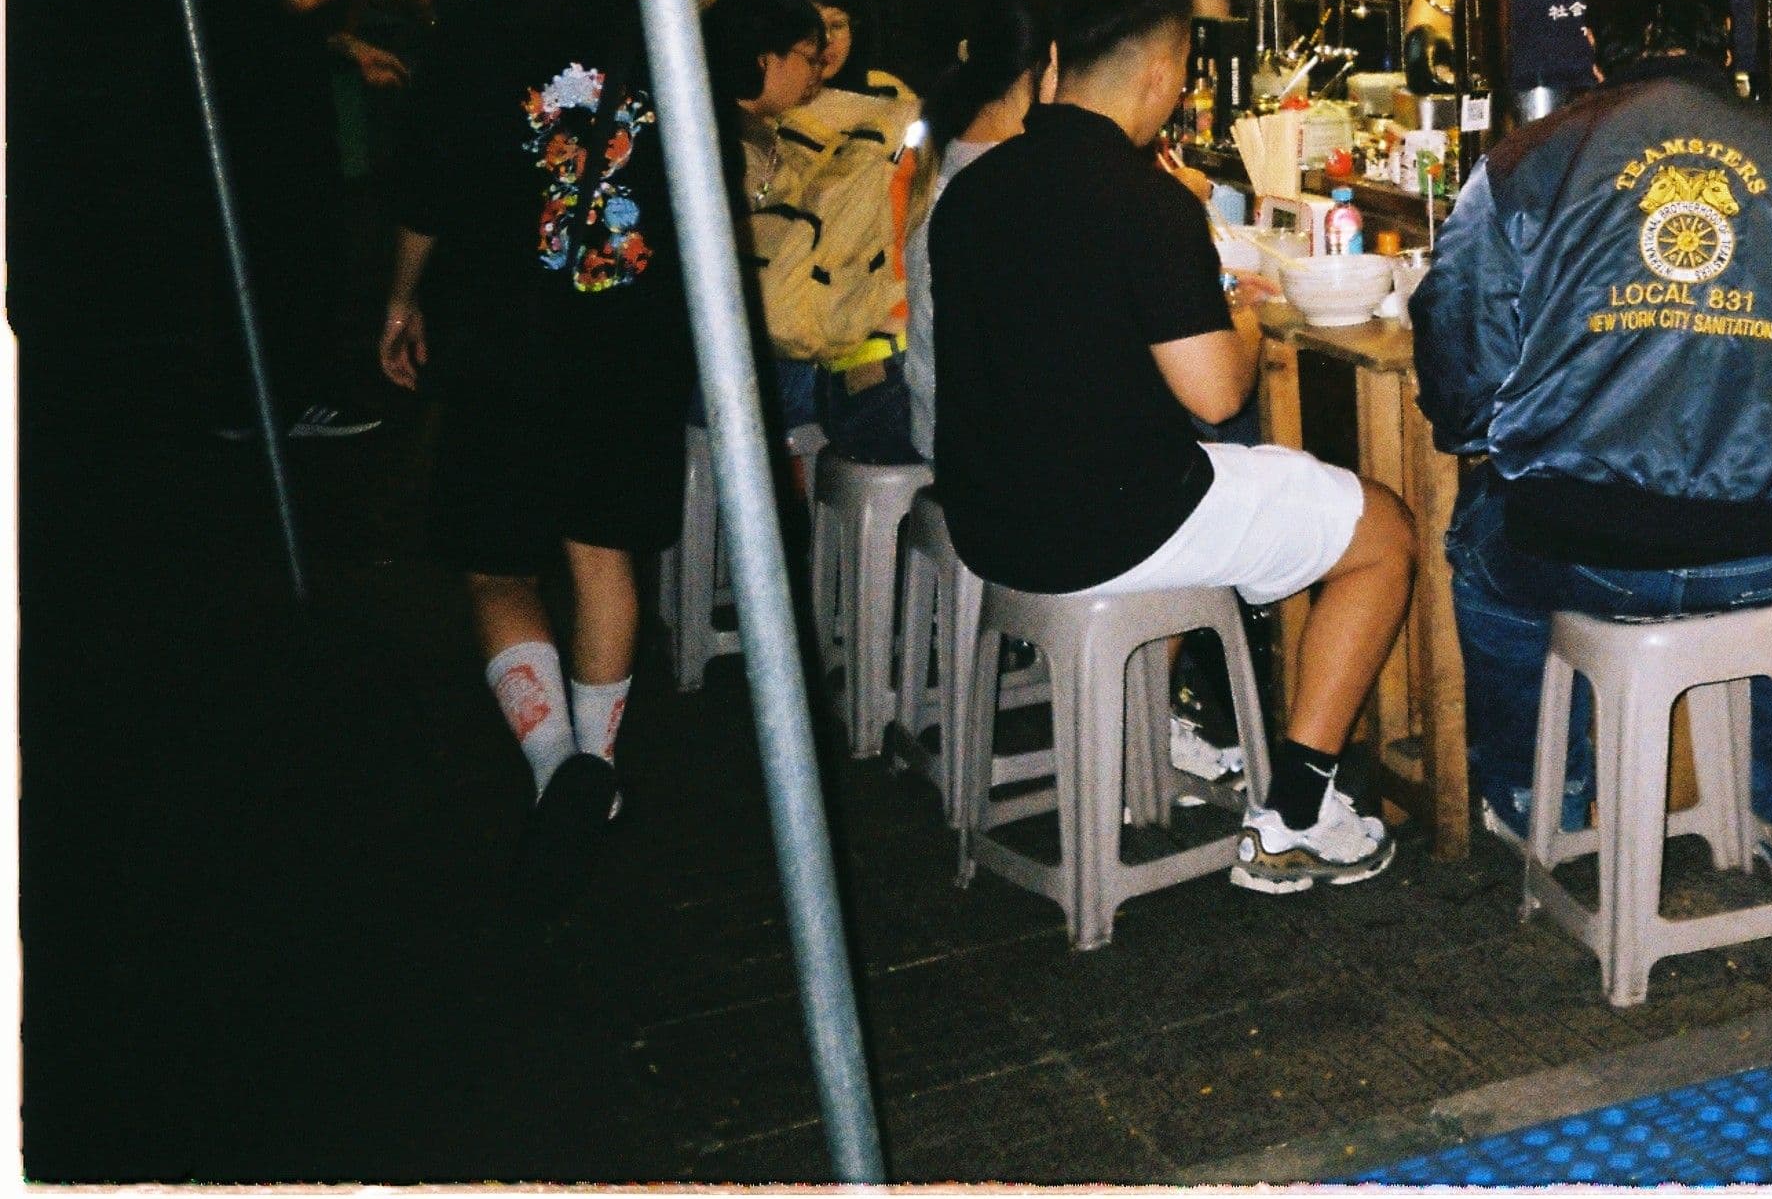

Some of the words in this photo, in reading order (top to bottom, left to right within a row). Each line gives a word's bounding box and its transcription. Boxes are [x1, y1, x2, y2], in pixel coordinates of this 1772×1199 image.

[1616, 138, 1767, 194] TEAMSTERS
[1660, 202, 1725, 227] BROTHERHOOD
[1611, 285, 1696, 307] LOCAL
[1707, 286, 1755, 313] 831
[1588, 313, 1616, 333] NEW
[1620, 310, 1656, 331] YORK
[1660, 310, 1692, 331] CITY
